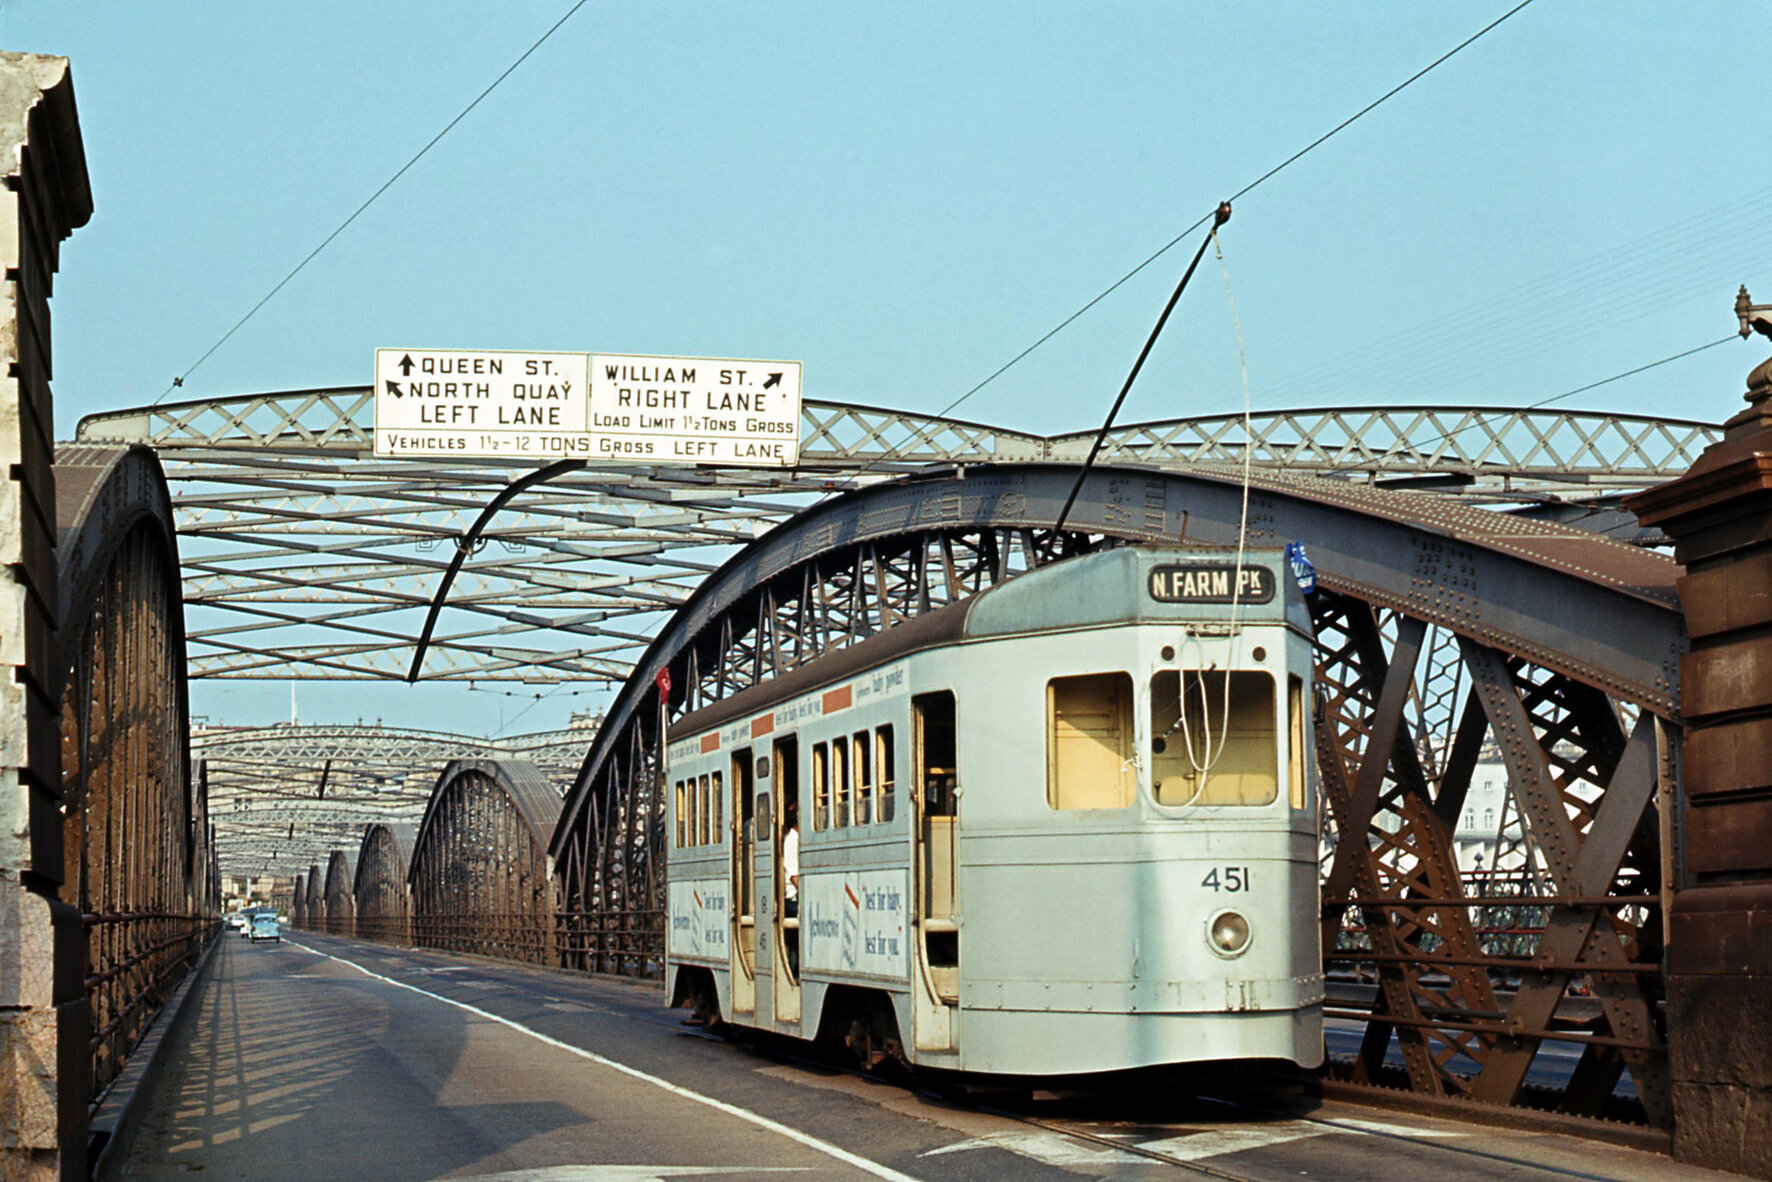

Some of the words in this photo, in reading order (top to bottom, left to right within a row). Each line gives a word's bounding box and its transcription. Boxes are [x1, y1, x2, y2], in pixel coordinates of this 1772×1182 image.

[422, 357, 503, 375] QUEEN
[525, 360, 559, 376] ST.
[605, 365, 696, 384] WILLIAM
[719, 369, 753, 386] ST.
[409, 382, 490, 399] NORTH
[513, 383, 571, 401] QUAY
[618, 388, 691, 409] RIGHT
[707, 391, 766, 412] LANE
[421, 404, 479, 424] LEFT
[498, 405, 561, 425] LANE
[594, 412, 630, 428] LOAD
[640, 414, 675, 430] LIMIT
[746, 418, 794, 434] GROSS
[387, 434, 466, 450] VEHICLES
[540, 437, 590, 451] TONS
[599, 438, 654, 454] GROSS
[674, 441, 718, 456] LEFT
[734, 443, 784, 459] LANE
[1172, 571, 1228, 597] FARM
[1201, 866, 1249, 892] 451
